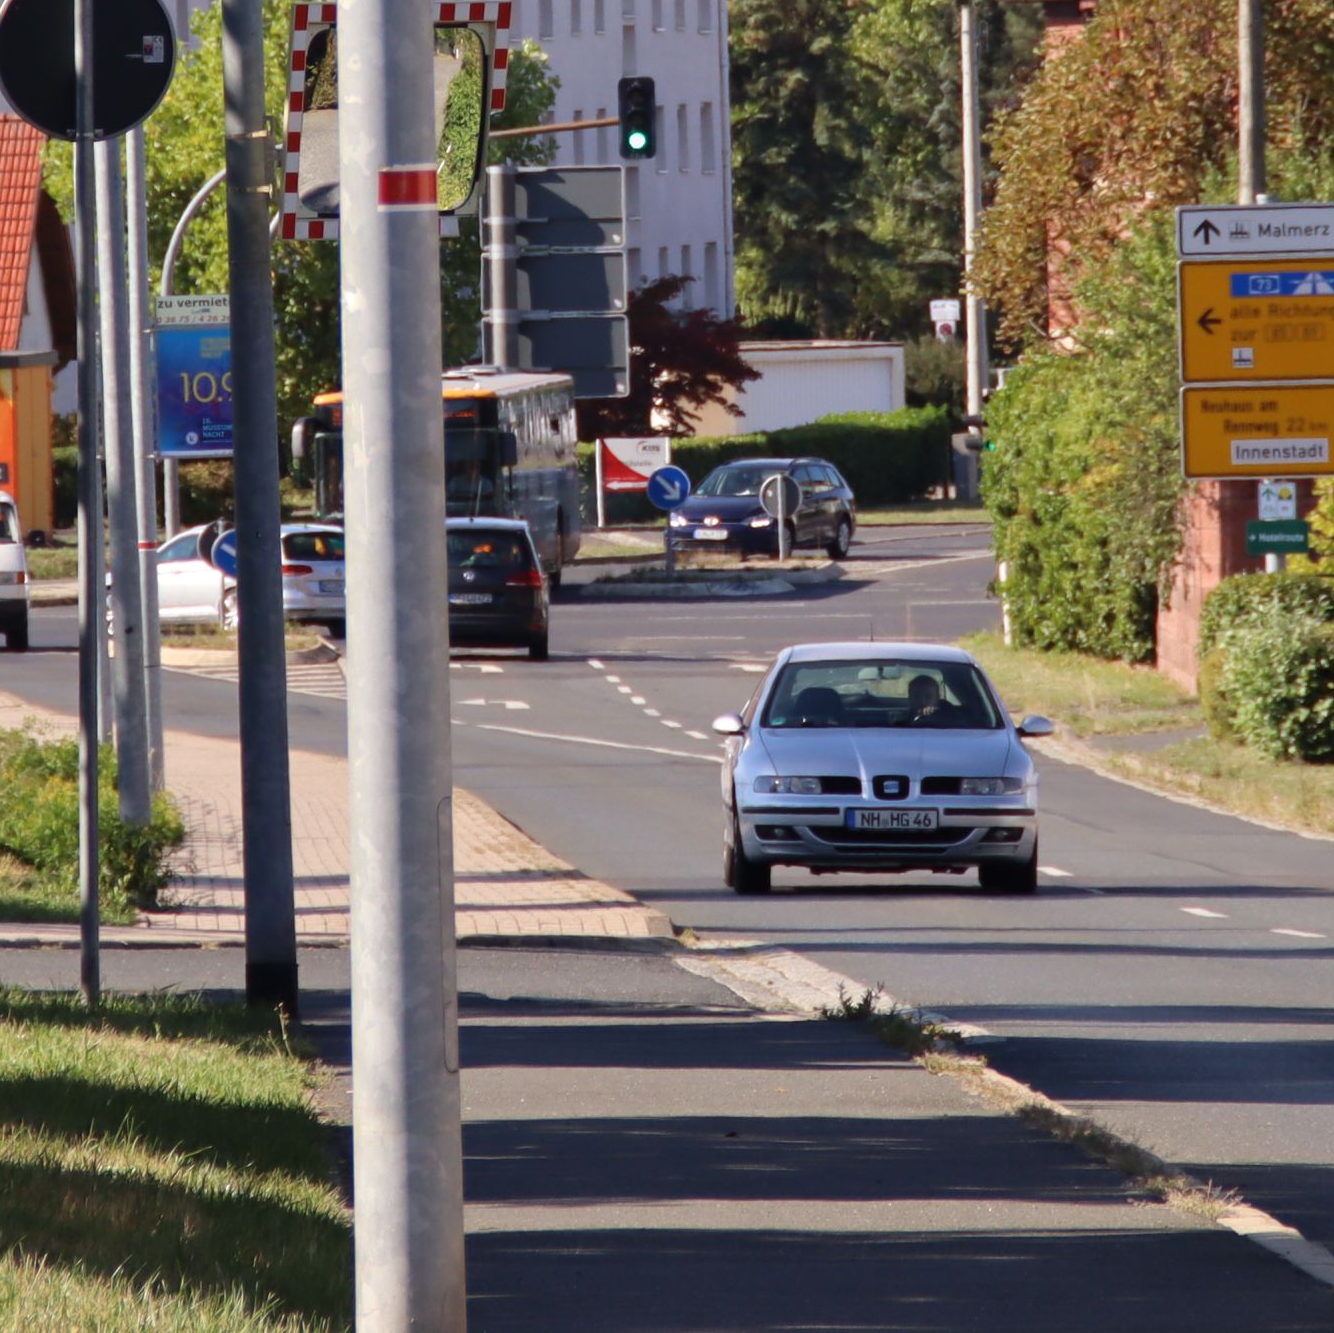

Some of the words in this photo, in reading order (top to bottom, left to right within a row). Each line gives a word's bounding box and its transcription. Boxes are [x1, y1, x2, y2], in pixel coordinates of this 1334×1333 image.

[1257, 222, 1330, 238] Malmerz
[157, 300, 173, 309] zu
[177, 297, 228, 307] vermiet
[1285, 418, 1305, 433] 22
[1235, 444, 1325, 460] Innenstadt
[889, 812, 911, 827] HG
[913, 812, 932, 827] 46
